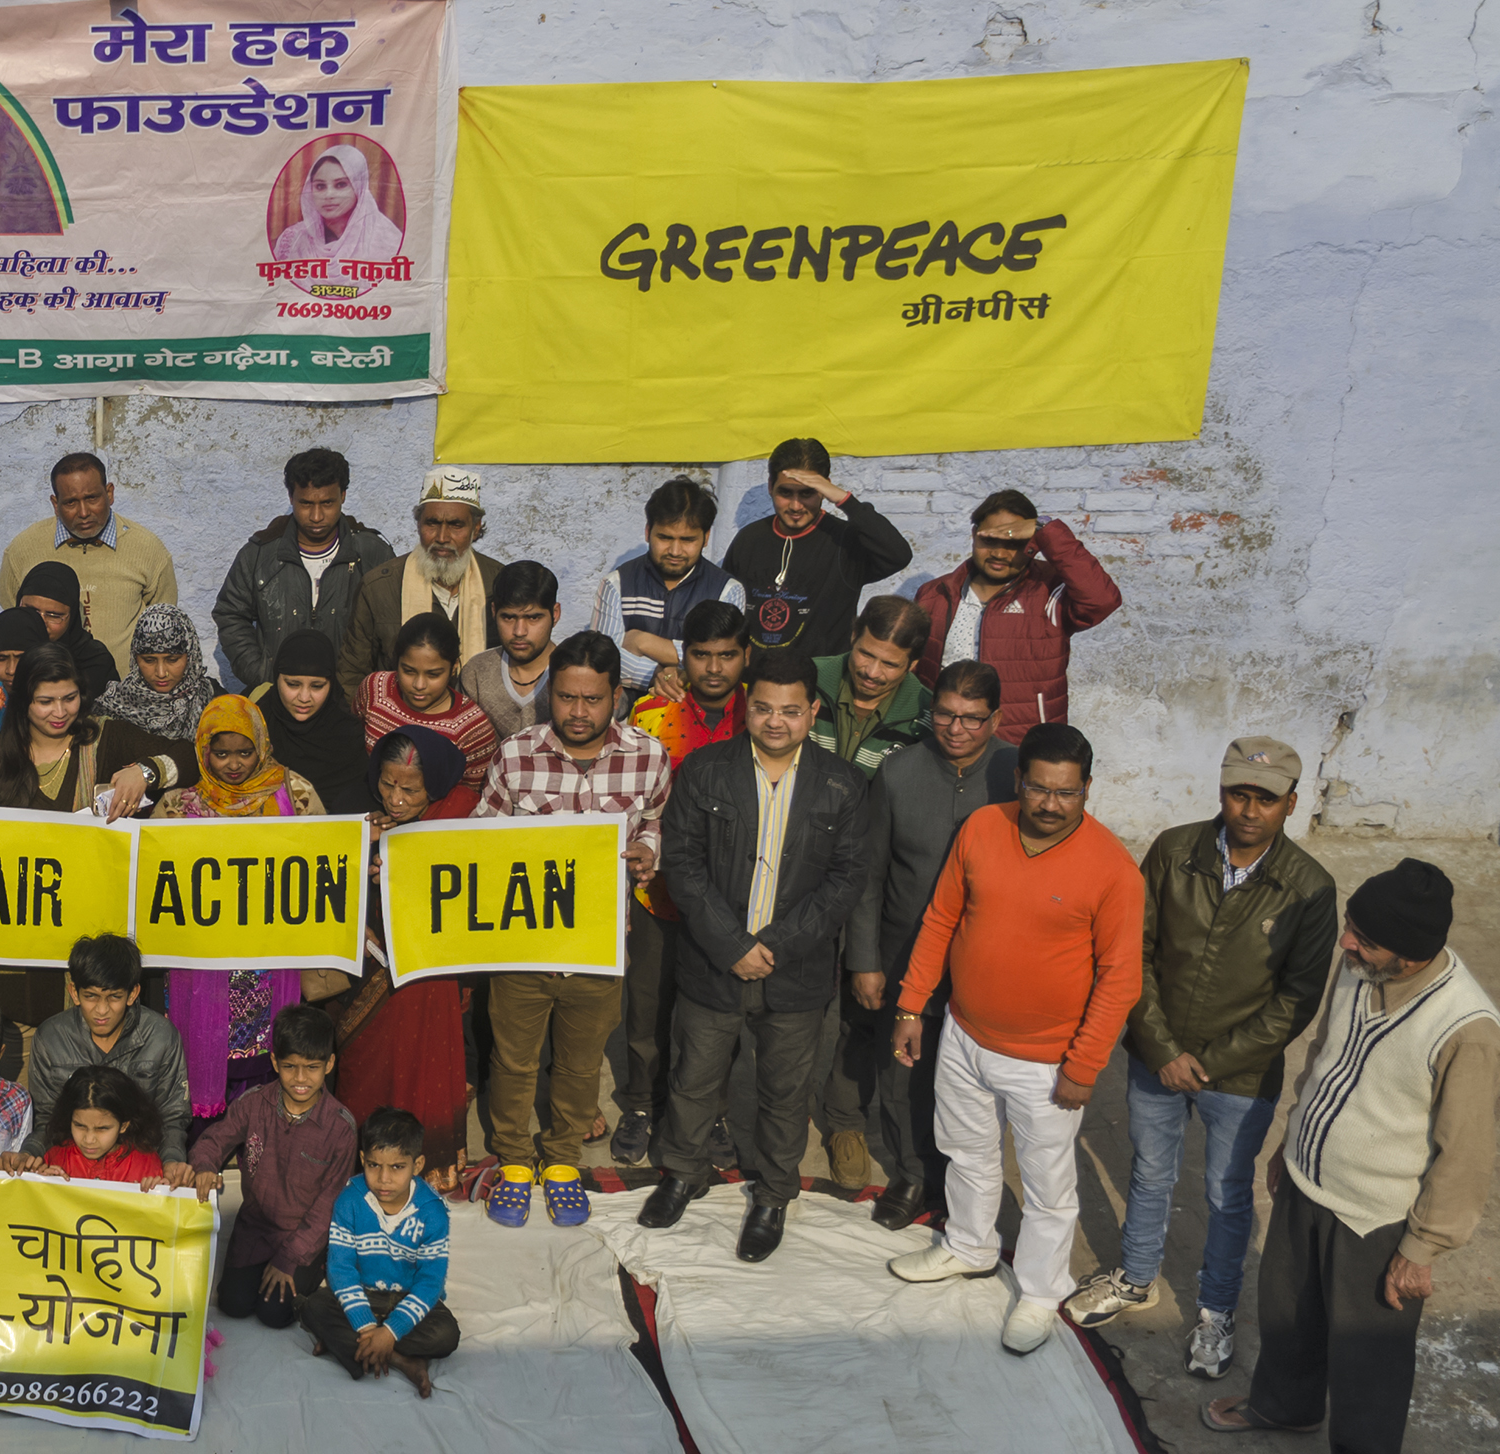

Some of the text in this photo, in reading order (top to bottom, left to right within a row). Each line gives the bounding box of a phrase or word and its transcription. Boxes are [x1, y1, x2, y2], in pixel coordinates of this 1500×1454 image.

[91, 9, 356, 75] मेरा हक़
[53, 77, 391, 135] फाउन्डेशन
[339, 256, 414, 287] नक़वी
[600, 213, 1067, 292] GREENPEACE
[43, 286, 80, 310] की
[81, 291, 171, 314] आवाज़
[276, 302, 392, 321] 7669380049
[311, 285, 359, 298] अध्यक्ष
[901, 290, 1051, 327] ग्रीनपीस
[144, 348, 198, 367] गेट
[310, 345, 394, 368] बरेली
[83, 591, 92, 633] JEA
[150, 854, 348, 927] ACTION
[430, 858, 576, 934] PLAN
[8, 1214, 165, 1298] चाहिए
